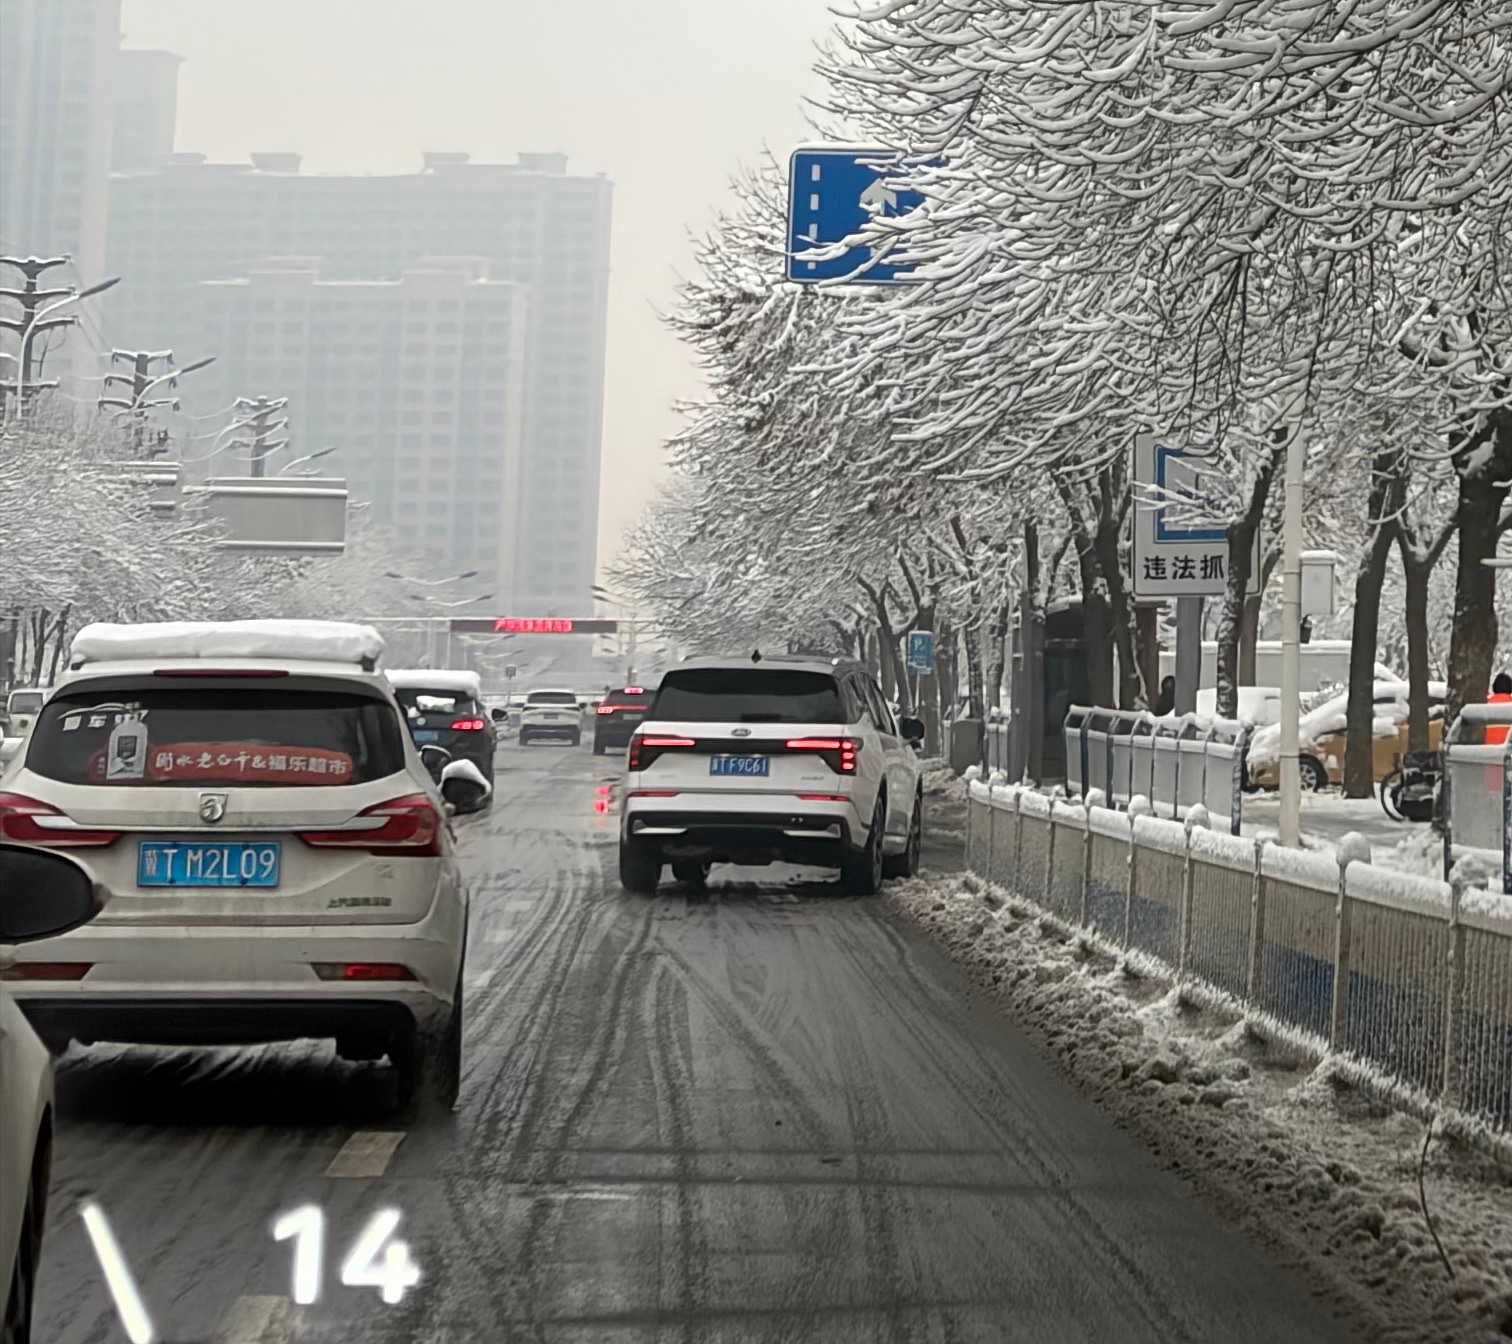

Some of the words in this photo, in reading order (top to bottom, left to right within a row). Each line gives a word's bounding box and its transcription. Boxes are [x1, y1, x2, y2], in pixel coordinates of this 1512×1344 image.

[1143, 554, 1225, 581] 违法抓
[273, 1203, 422, 1305] 14
